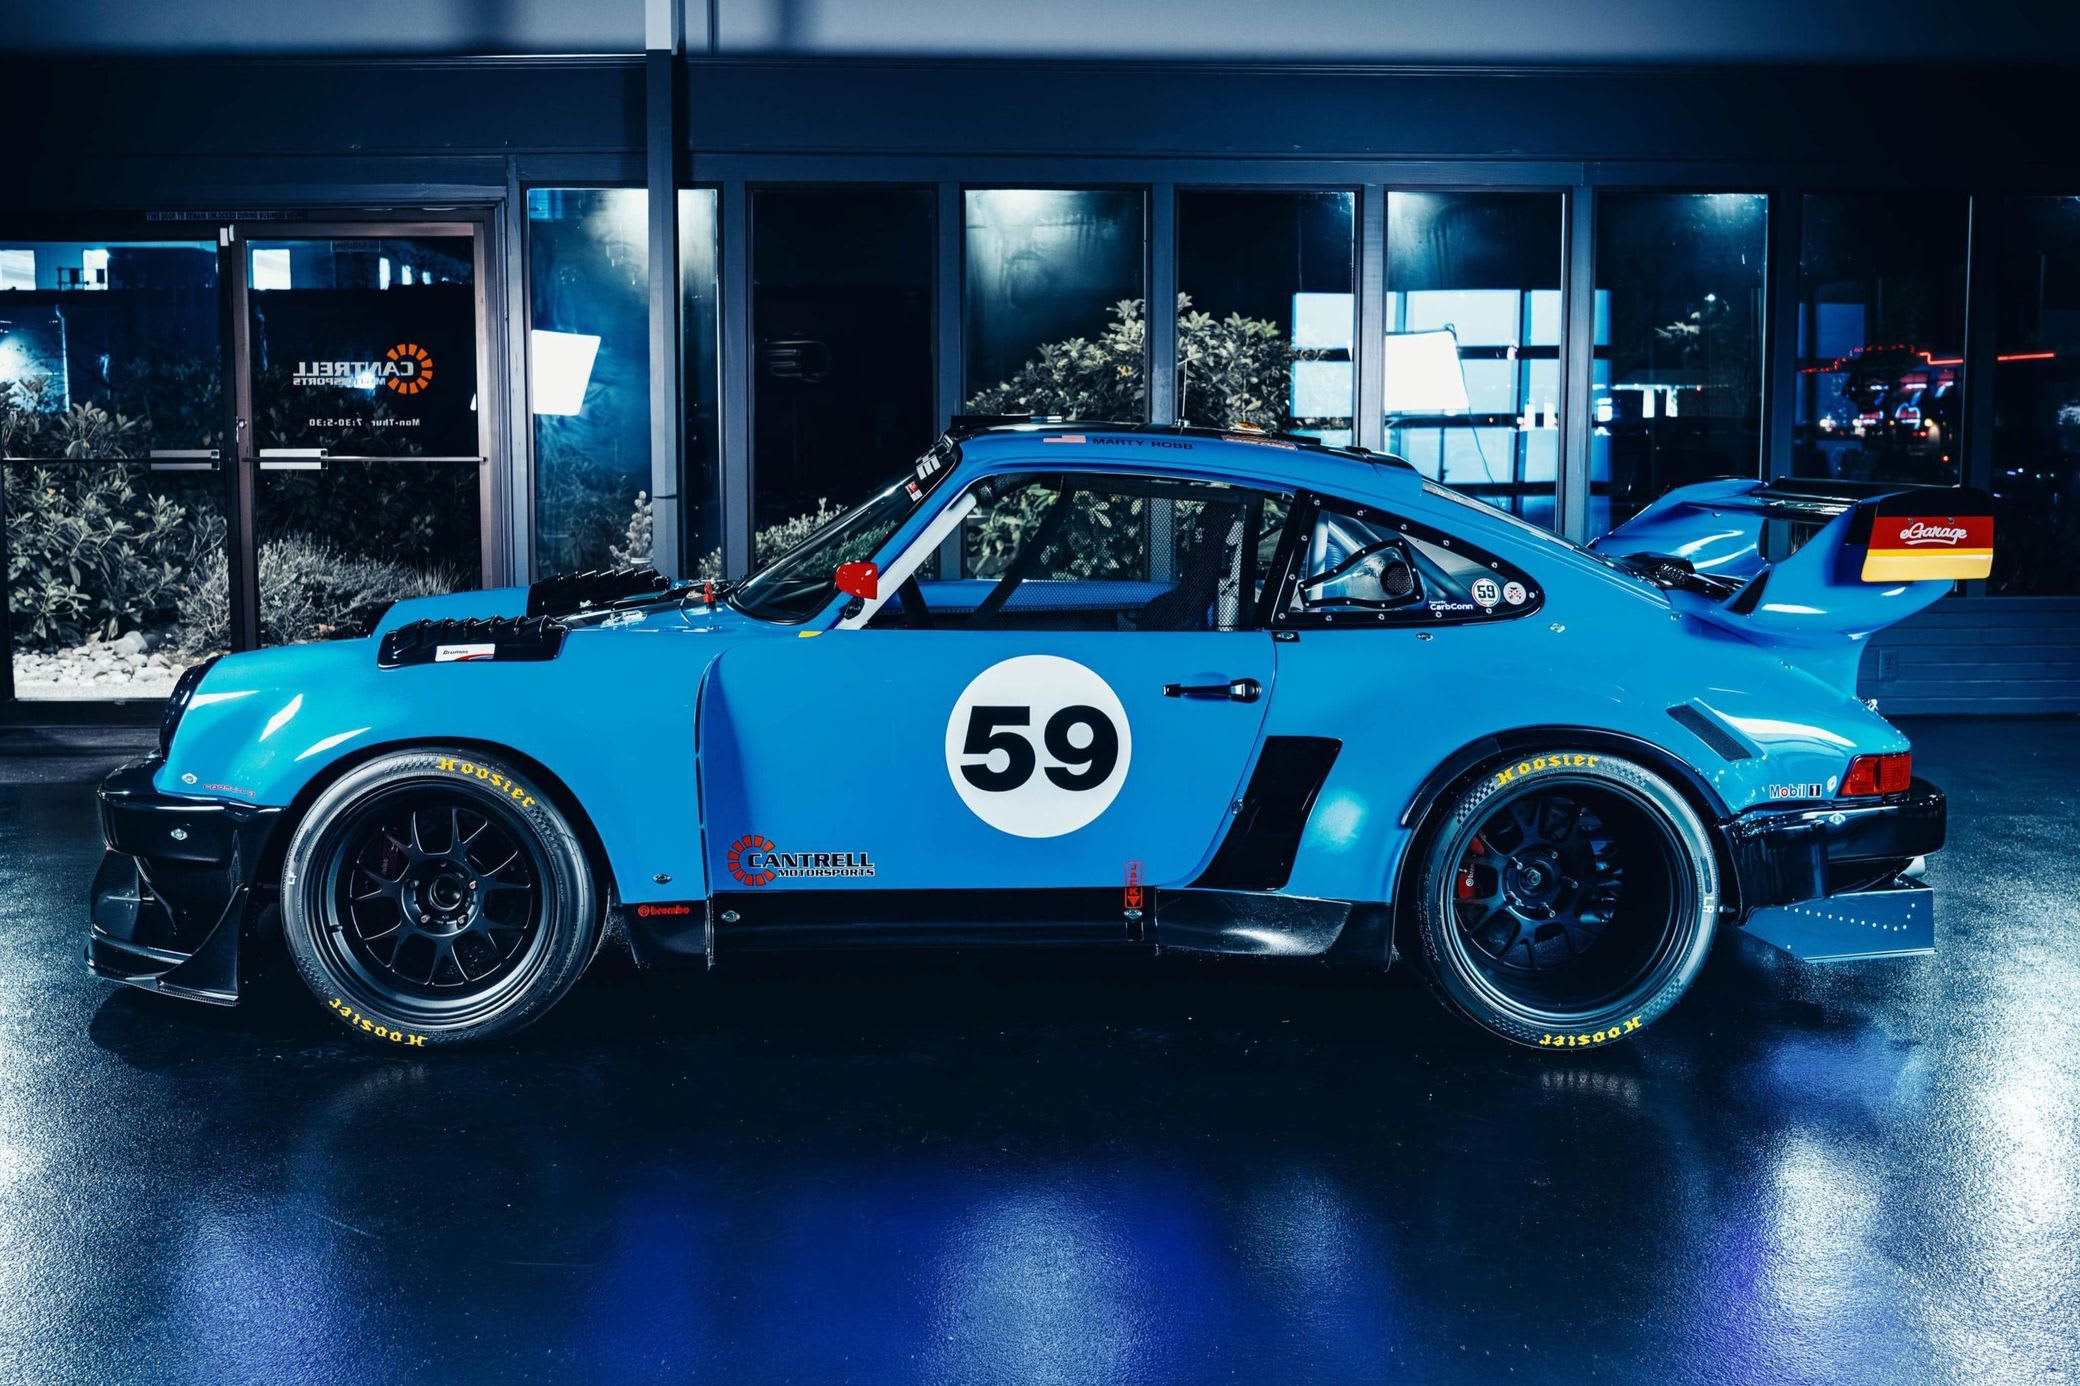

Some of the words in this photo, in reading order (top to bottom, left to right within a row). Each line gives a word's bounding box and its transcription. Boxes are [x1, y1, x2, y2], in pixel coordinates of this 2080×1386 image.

[1092, 438, 1144, 446] MARTY
[1151, 441, 1193, 450] ROBB
[1900, 522, 1967, 545] eGarage
[1477, 584, 1496, 599] 59
[1430, 603, 1473, 611] CarbConn
[960, 704, 1119, 793] 59
[1495, 754, 1599, 786] Hoosier
[435, 757, 536, 808] Hoosier
[1769, 784, 1806, 798] Mobil
[747, 852, 875, 868] CANTRELL
[778, 868, 876, 878] MOTORSPORTS
[650, 905, 690, 915] brembo
[1702, 896, 1715, 914] LR
[329, 999, 428, 1047] Hoosier
[1539, 1015, 1642, 1047] Hoosier
